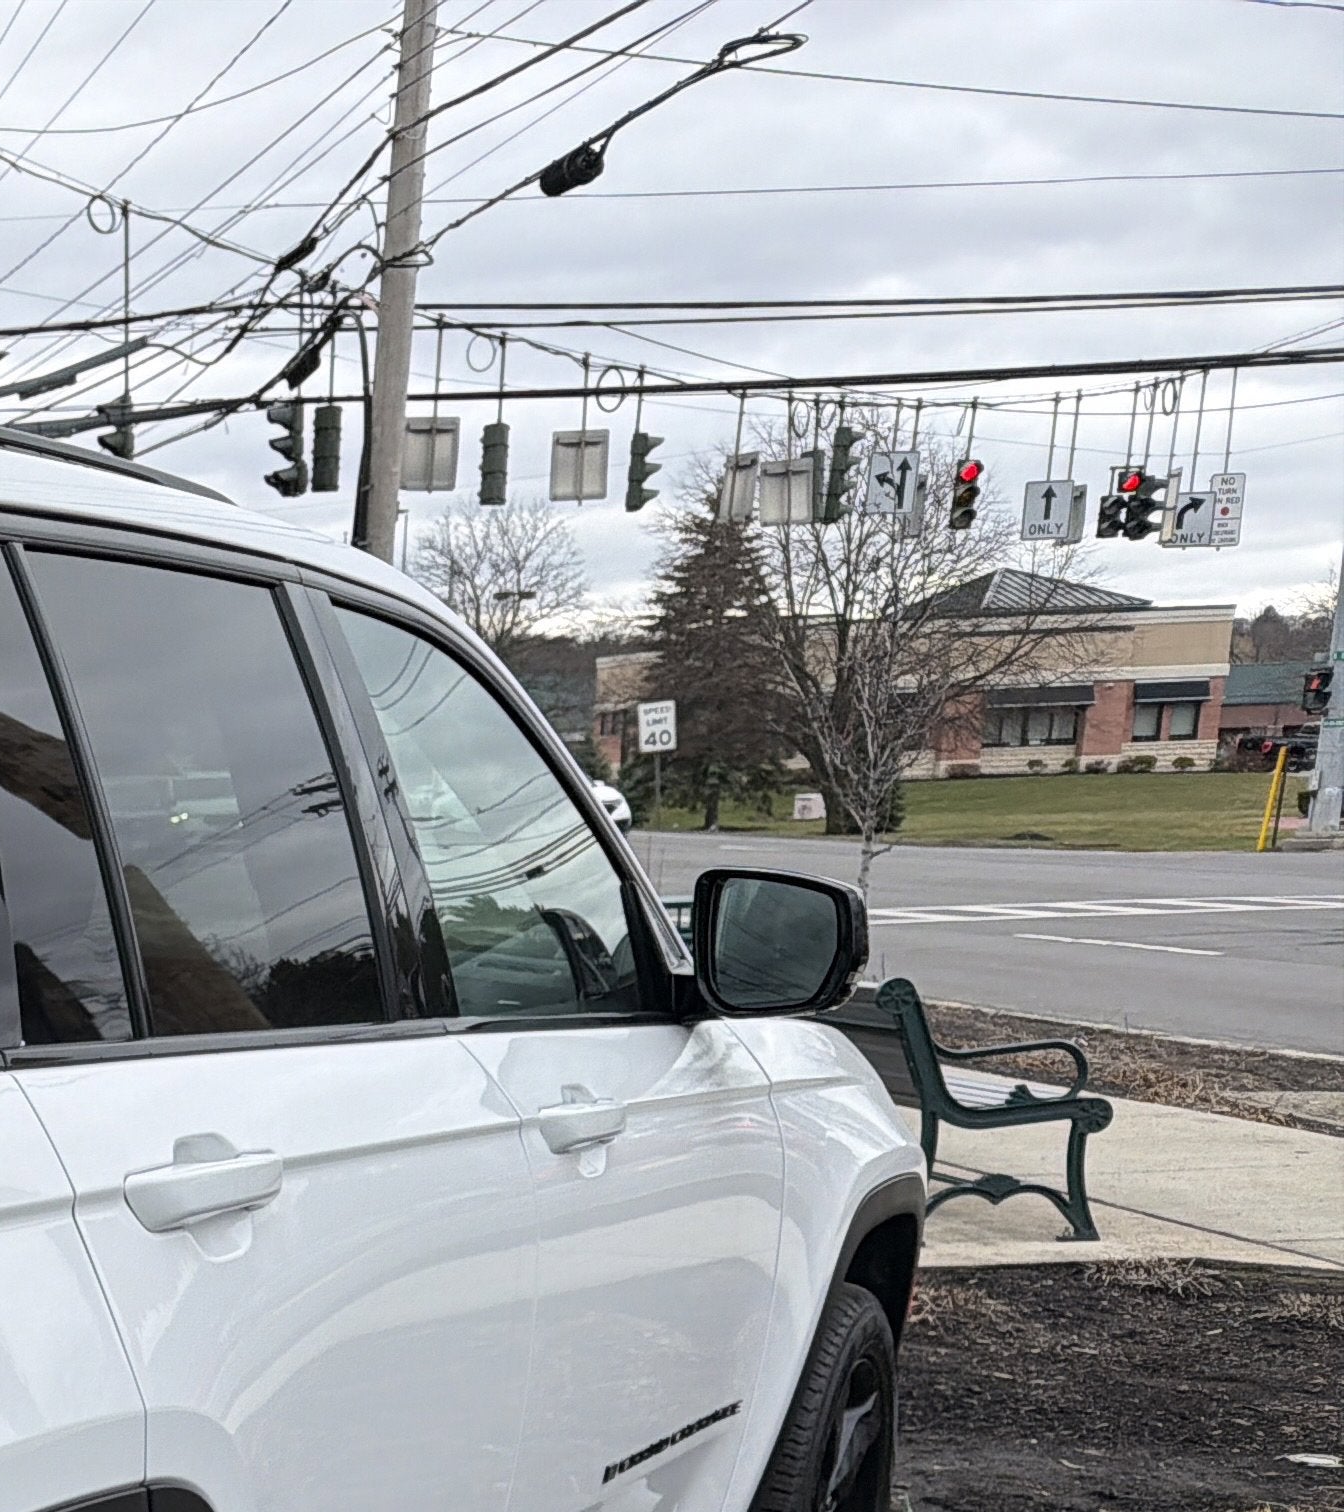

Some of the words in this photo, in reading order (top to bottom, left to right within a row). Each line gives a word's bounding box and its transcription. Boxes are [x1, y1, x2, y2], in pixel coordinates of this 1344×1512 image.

[1221, 477, 1236, 486] NO
[1028, 523, 1064, 535] ONLY
[1172, 533, 1205, 544] ONLY
[644, 729, 672, 746] 40
